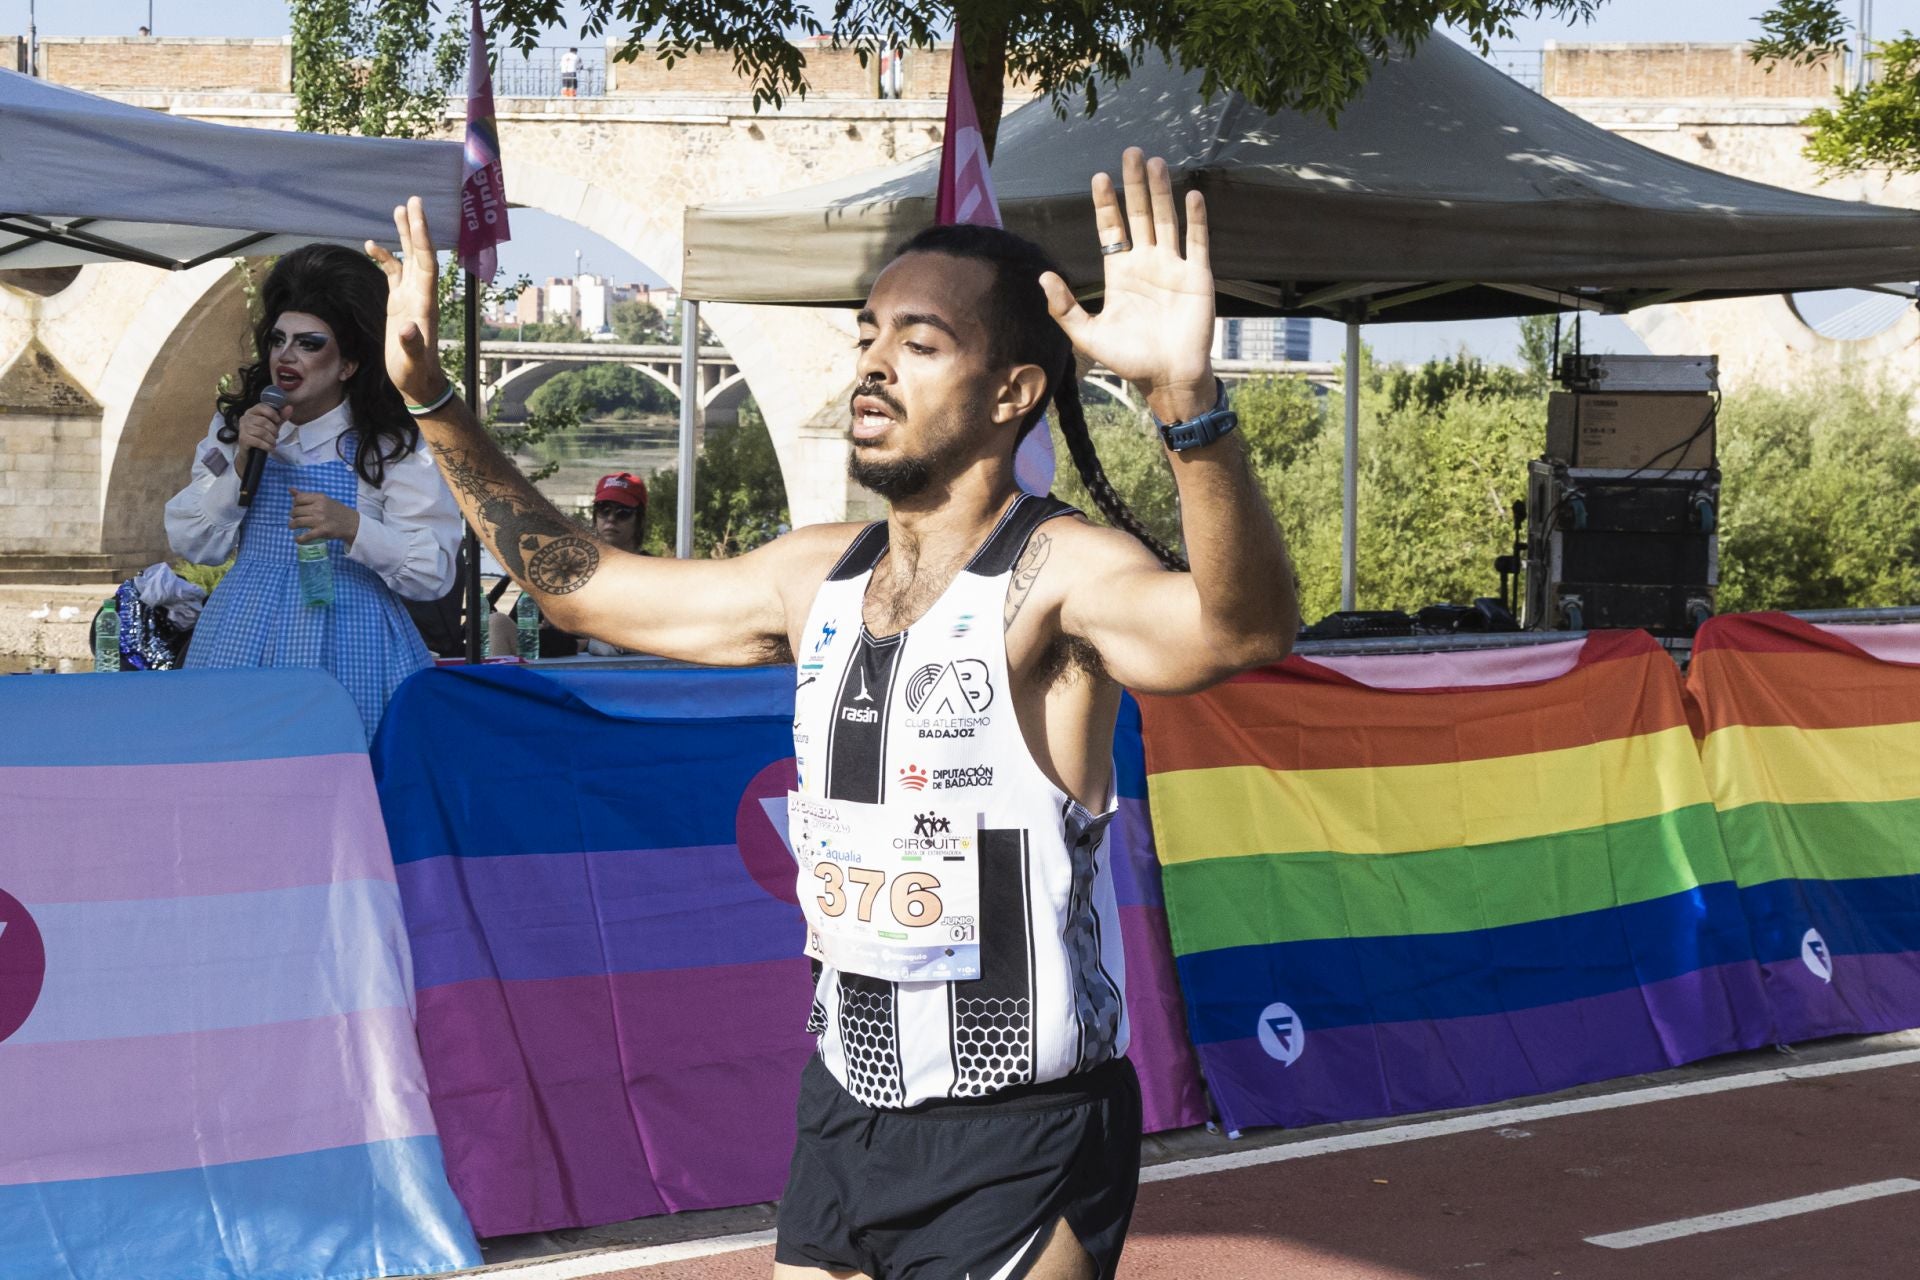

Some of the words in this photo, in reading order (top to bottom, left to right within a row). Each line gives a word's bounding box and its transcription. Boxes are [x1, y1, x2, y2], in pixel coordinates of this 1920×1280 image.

[841, 706, 879, 724] rasán
[905, 718, 930, 728] CLUB
[933, 716, 991, 728] ATLETISMO
[918, 728, 975, 739] BADAJOZ
[932, 764, 994, 780] DIPUTACIÓN
[945, 777, 993, 789] BADAJOZ
[825, 849, 862, 863] aqualia
[814, 861, 943, 928] 376
[940, 915, 975, 926] JUNIO
[949, 925, 975, 942] 01
